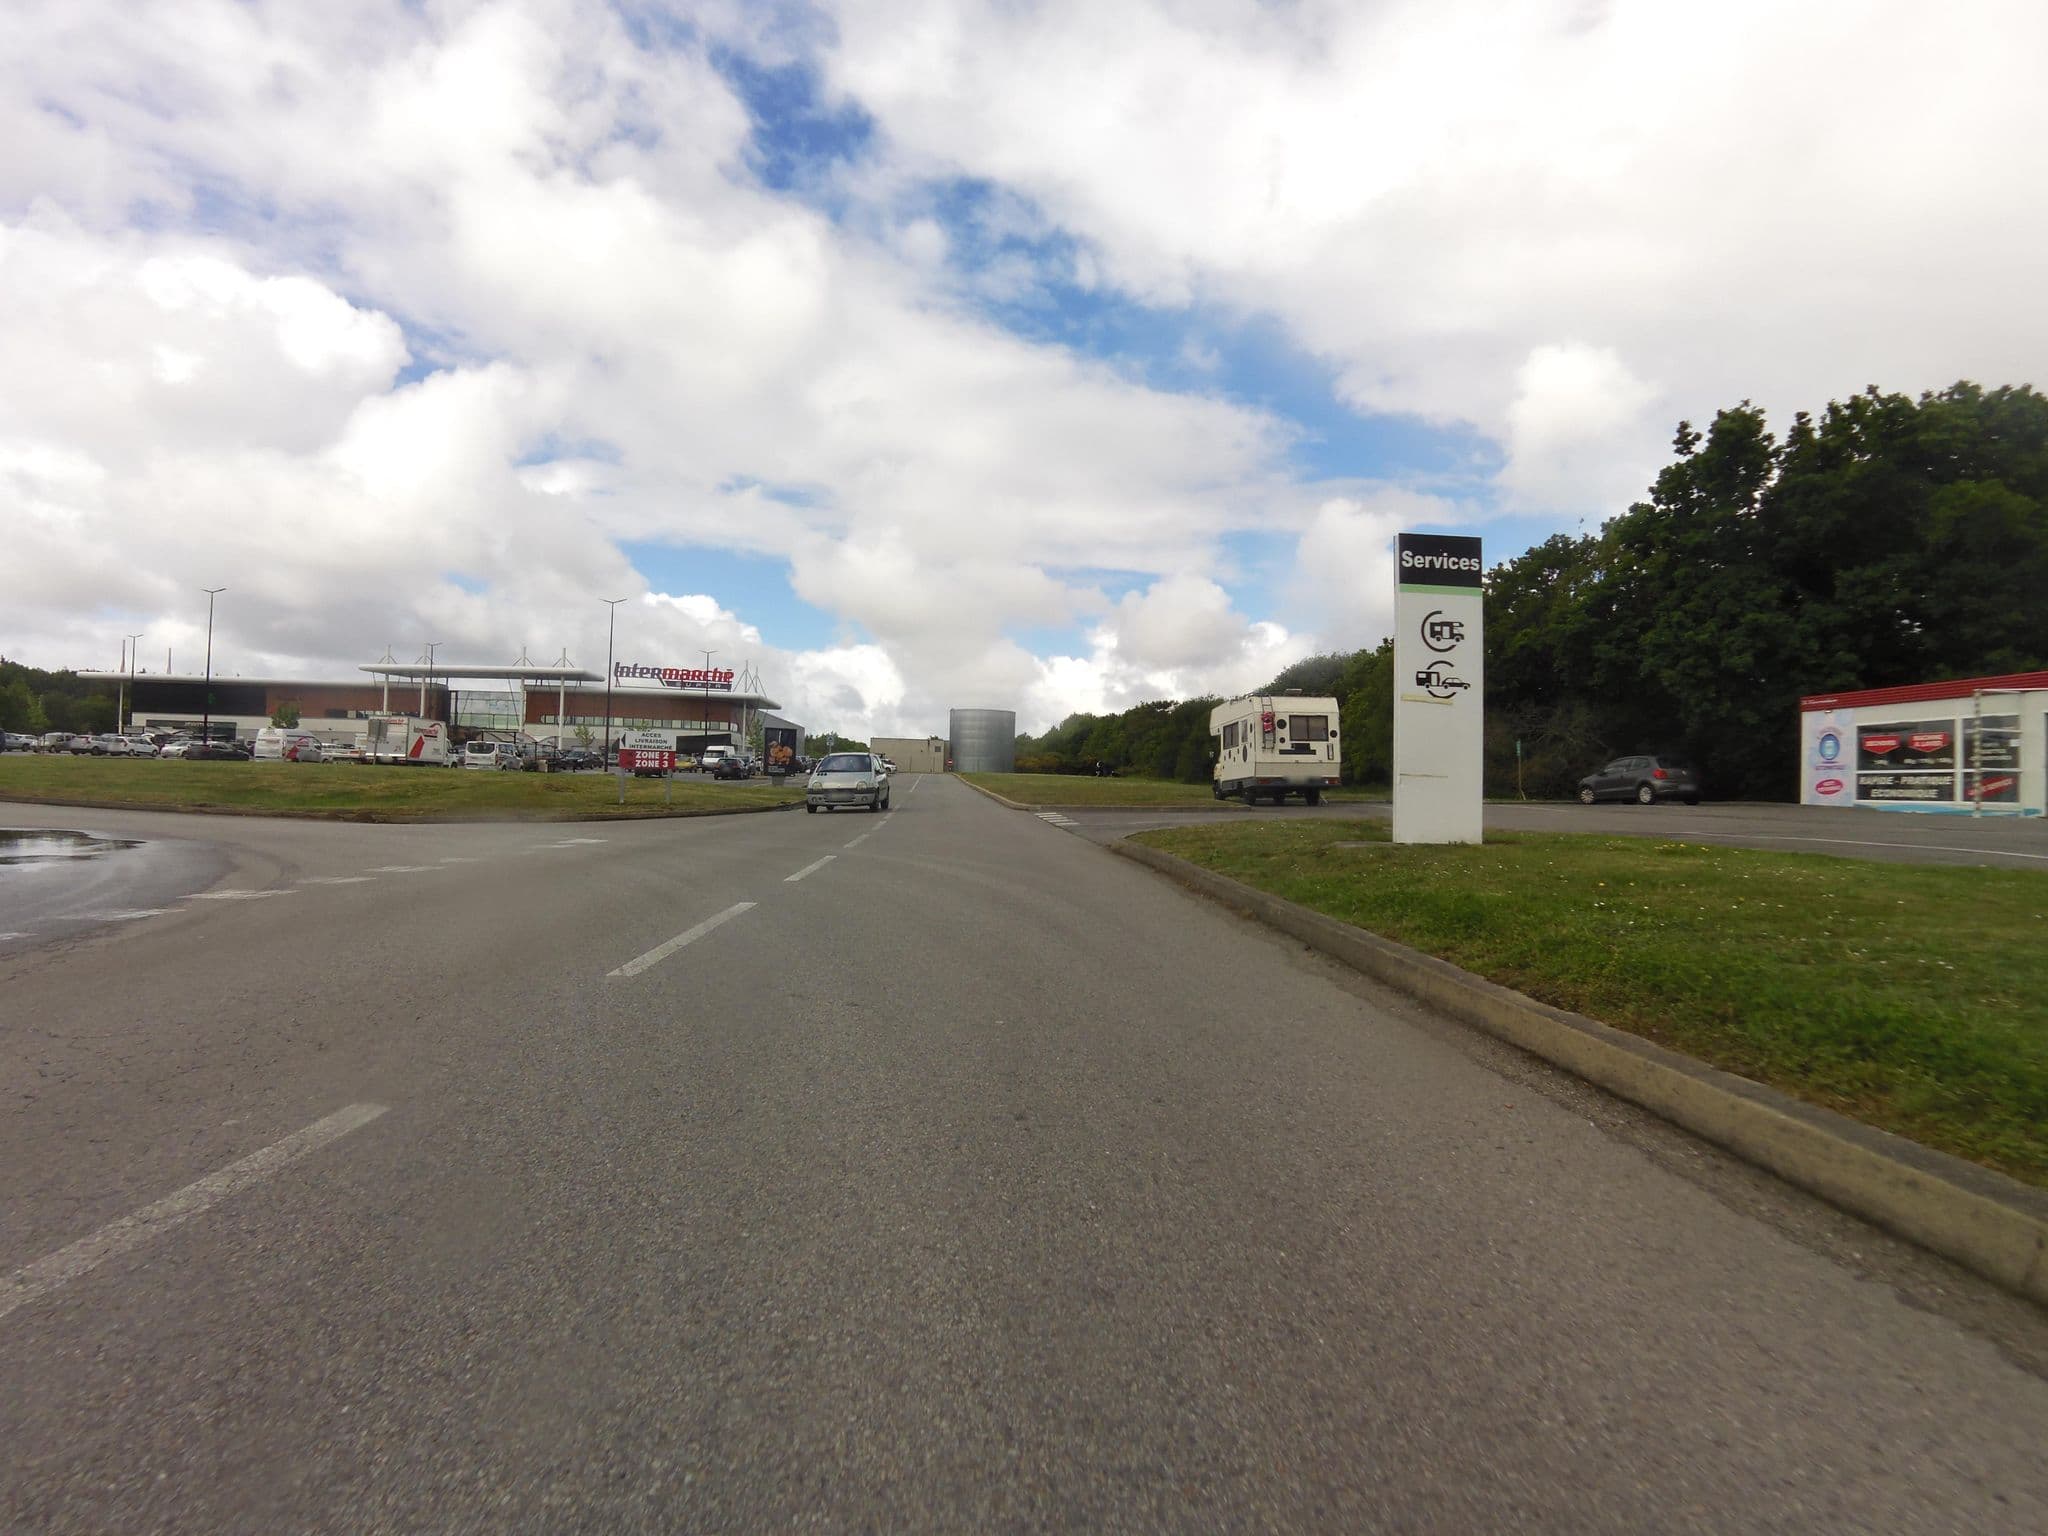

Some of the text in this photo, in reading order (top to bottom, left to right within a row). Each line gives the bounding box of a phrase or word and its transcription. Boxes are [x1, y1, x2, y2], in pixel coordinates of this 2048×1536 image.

[1401, 550, 1481, 571] Services
[635, 751, 670, 760] ZONE 2
[635, 760, 660, 768] ZONE
